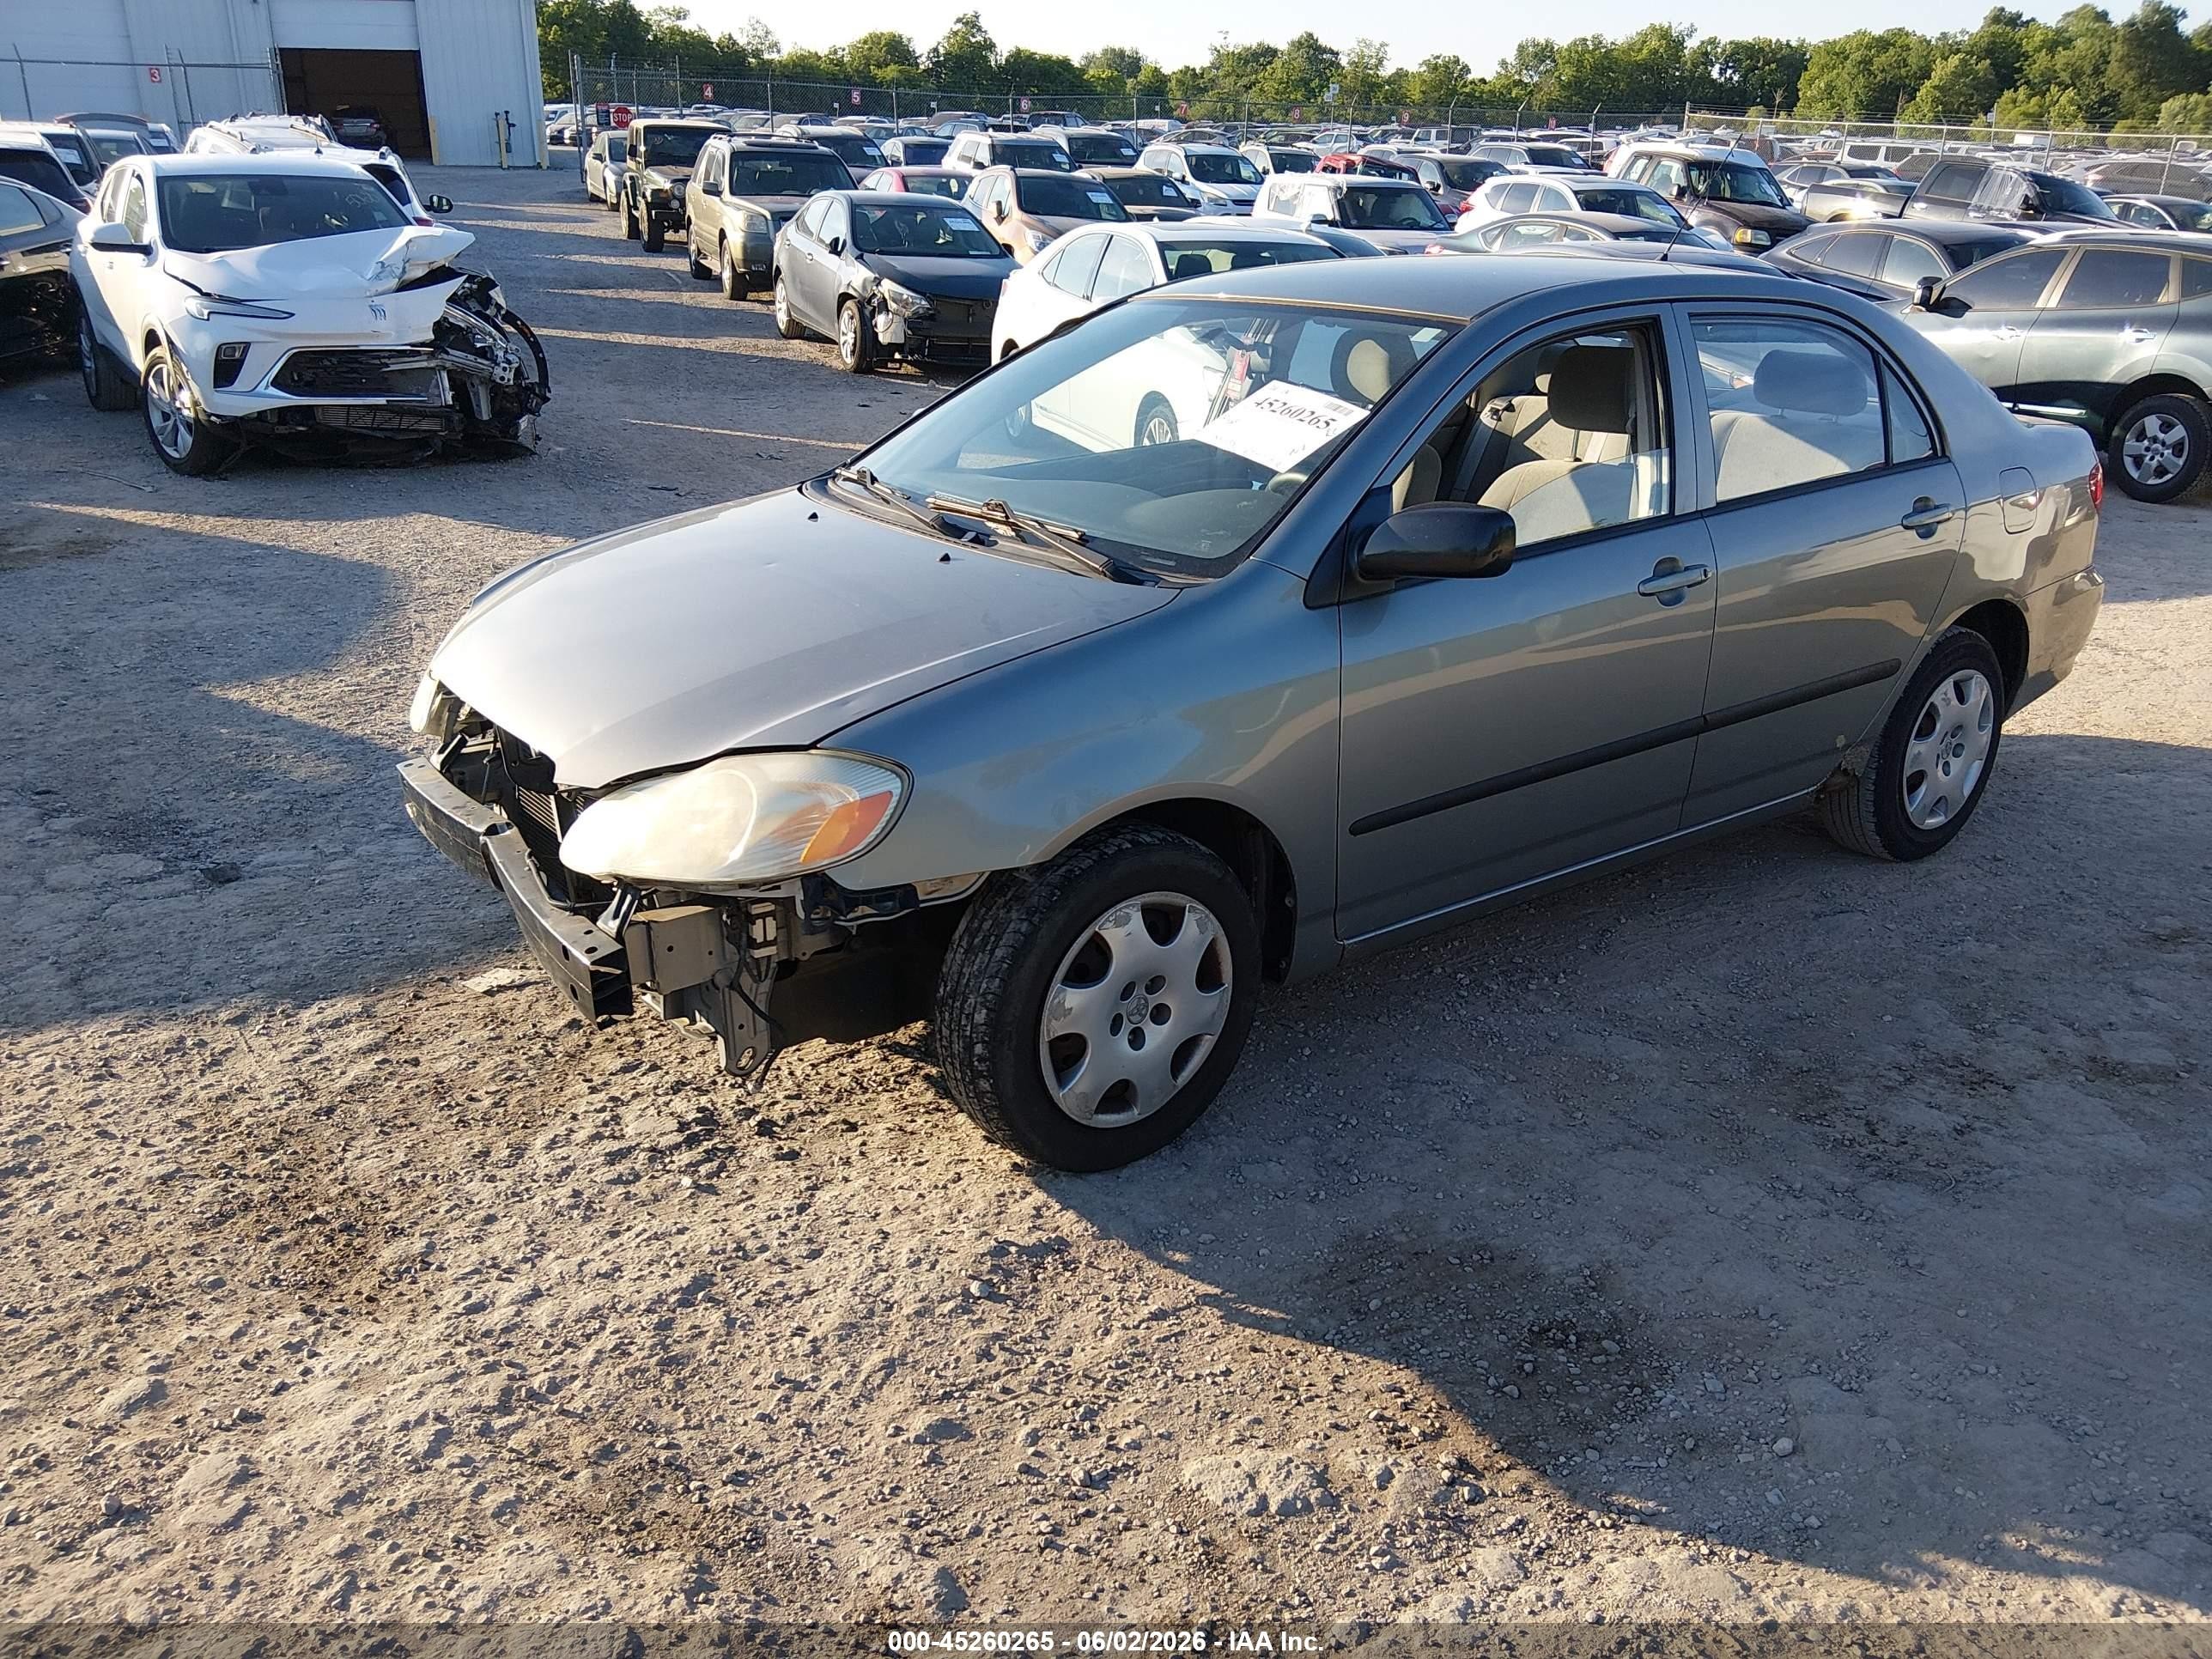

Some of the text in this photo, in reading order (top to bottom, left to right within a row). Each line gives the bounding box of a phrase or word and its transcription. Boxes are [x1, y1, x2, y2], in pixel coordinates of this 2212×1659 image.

[150, 69, 160, 82] 3
[705, 86, 713, 98] 4
[853, 91, 860, 103] 5
[1022, 99, 1028, 110] 6
[1181, 103, 1188, 114] 7
[613, 112, 633, 122] STOP
[1294, 108, 1300, 119] 8
[1402, 112, 1409, 122] 9
[1254, 397, 1338, 430] 45260265
